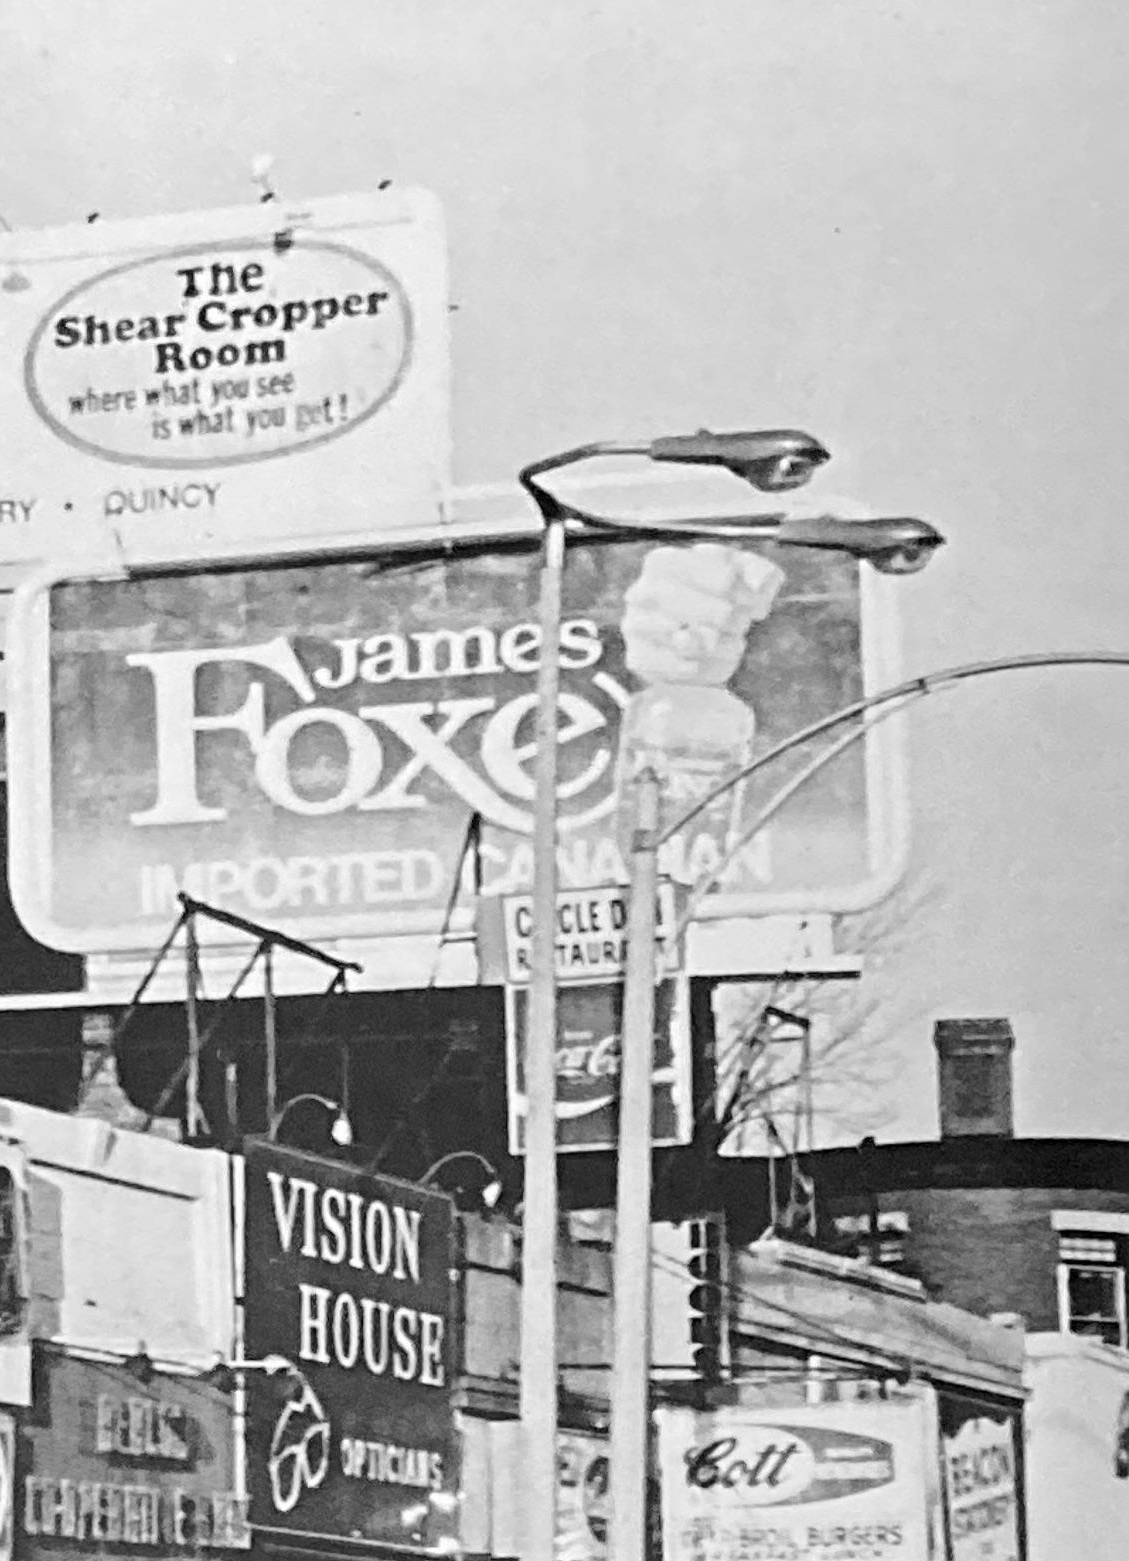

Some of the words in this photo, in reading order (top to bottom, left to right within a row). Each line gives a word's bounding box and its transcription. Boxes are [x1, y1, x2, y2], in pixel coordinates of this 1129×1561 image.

[176, 262, 265, 299] The
[54, 311, 186, 349] Shear
[197, 290, 390, 336] Cropper
[155, 338, 287, 375] Room
[69, 381, 137, 415] where
[143, 377, 202, 411] what
[211, 378, 249, 410] you
[256, 371, 296, 397] see
[152, 413, 171, 440] is
[179, 407, 235, 437] what
[245, 406, 287, 437] you
[295, 392, 349, 434] get!
[103, 482, 223, 517] QUINCY
[314, 616, 604, 692] James
[125, 636, 621, 836] Foxe
[138, 847, 453, 916] IMPORTED
[515, 899, 601, 939] CCLE
[267, 1170, 421, 1285] VISION
[298, 1283, 446, 1388] HOUSE
[340, 1436, 444, 1490] OPTICIANS
[683, 1437, 800, 1489] Cott
